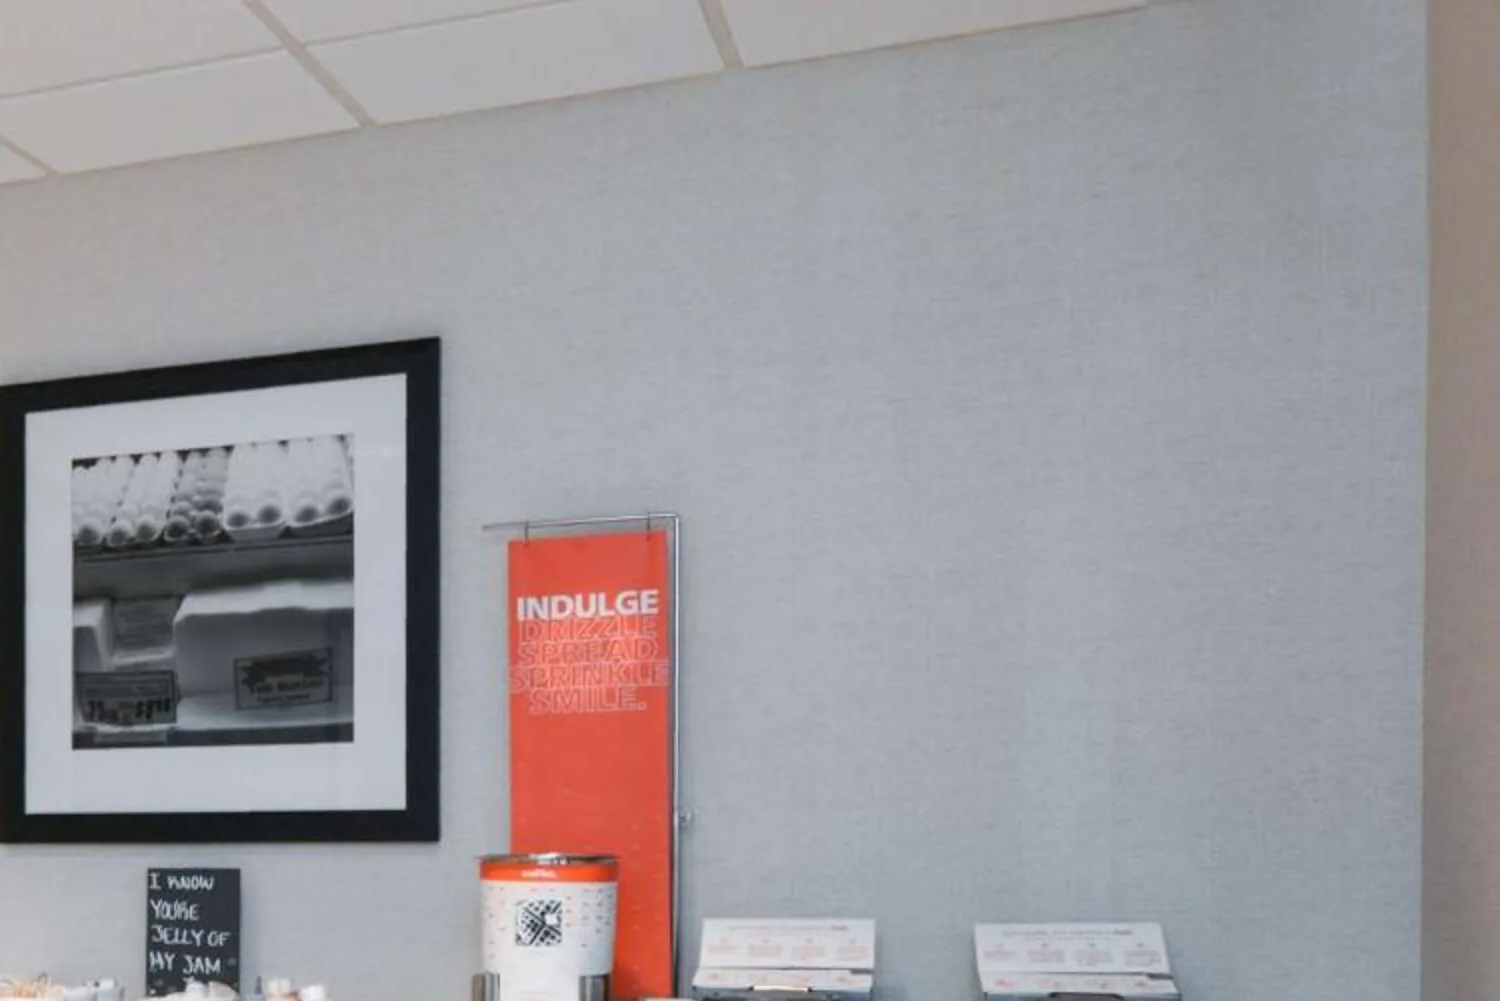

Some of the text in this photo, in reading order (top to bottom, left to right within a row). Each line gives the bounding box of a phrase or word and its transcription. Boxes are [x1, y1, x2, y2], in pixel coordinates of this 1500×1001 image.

[517, 589, 660, 621] INDULGE
[519, 616, 657, 643] DRIZZLE
[518, 637, 659, 667] SPREAD
[510, 659, 670, 693] SPRINKLE
[149, 873, 215, 890] I KNOW
[151, 924, 231, 947] JELLY OF
[149, 951, 221, 975] MY JAM
